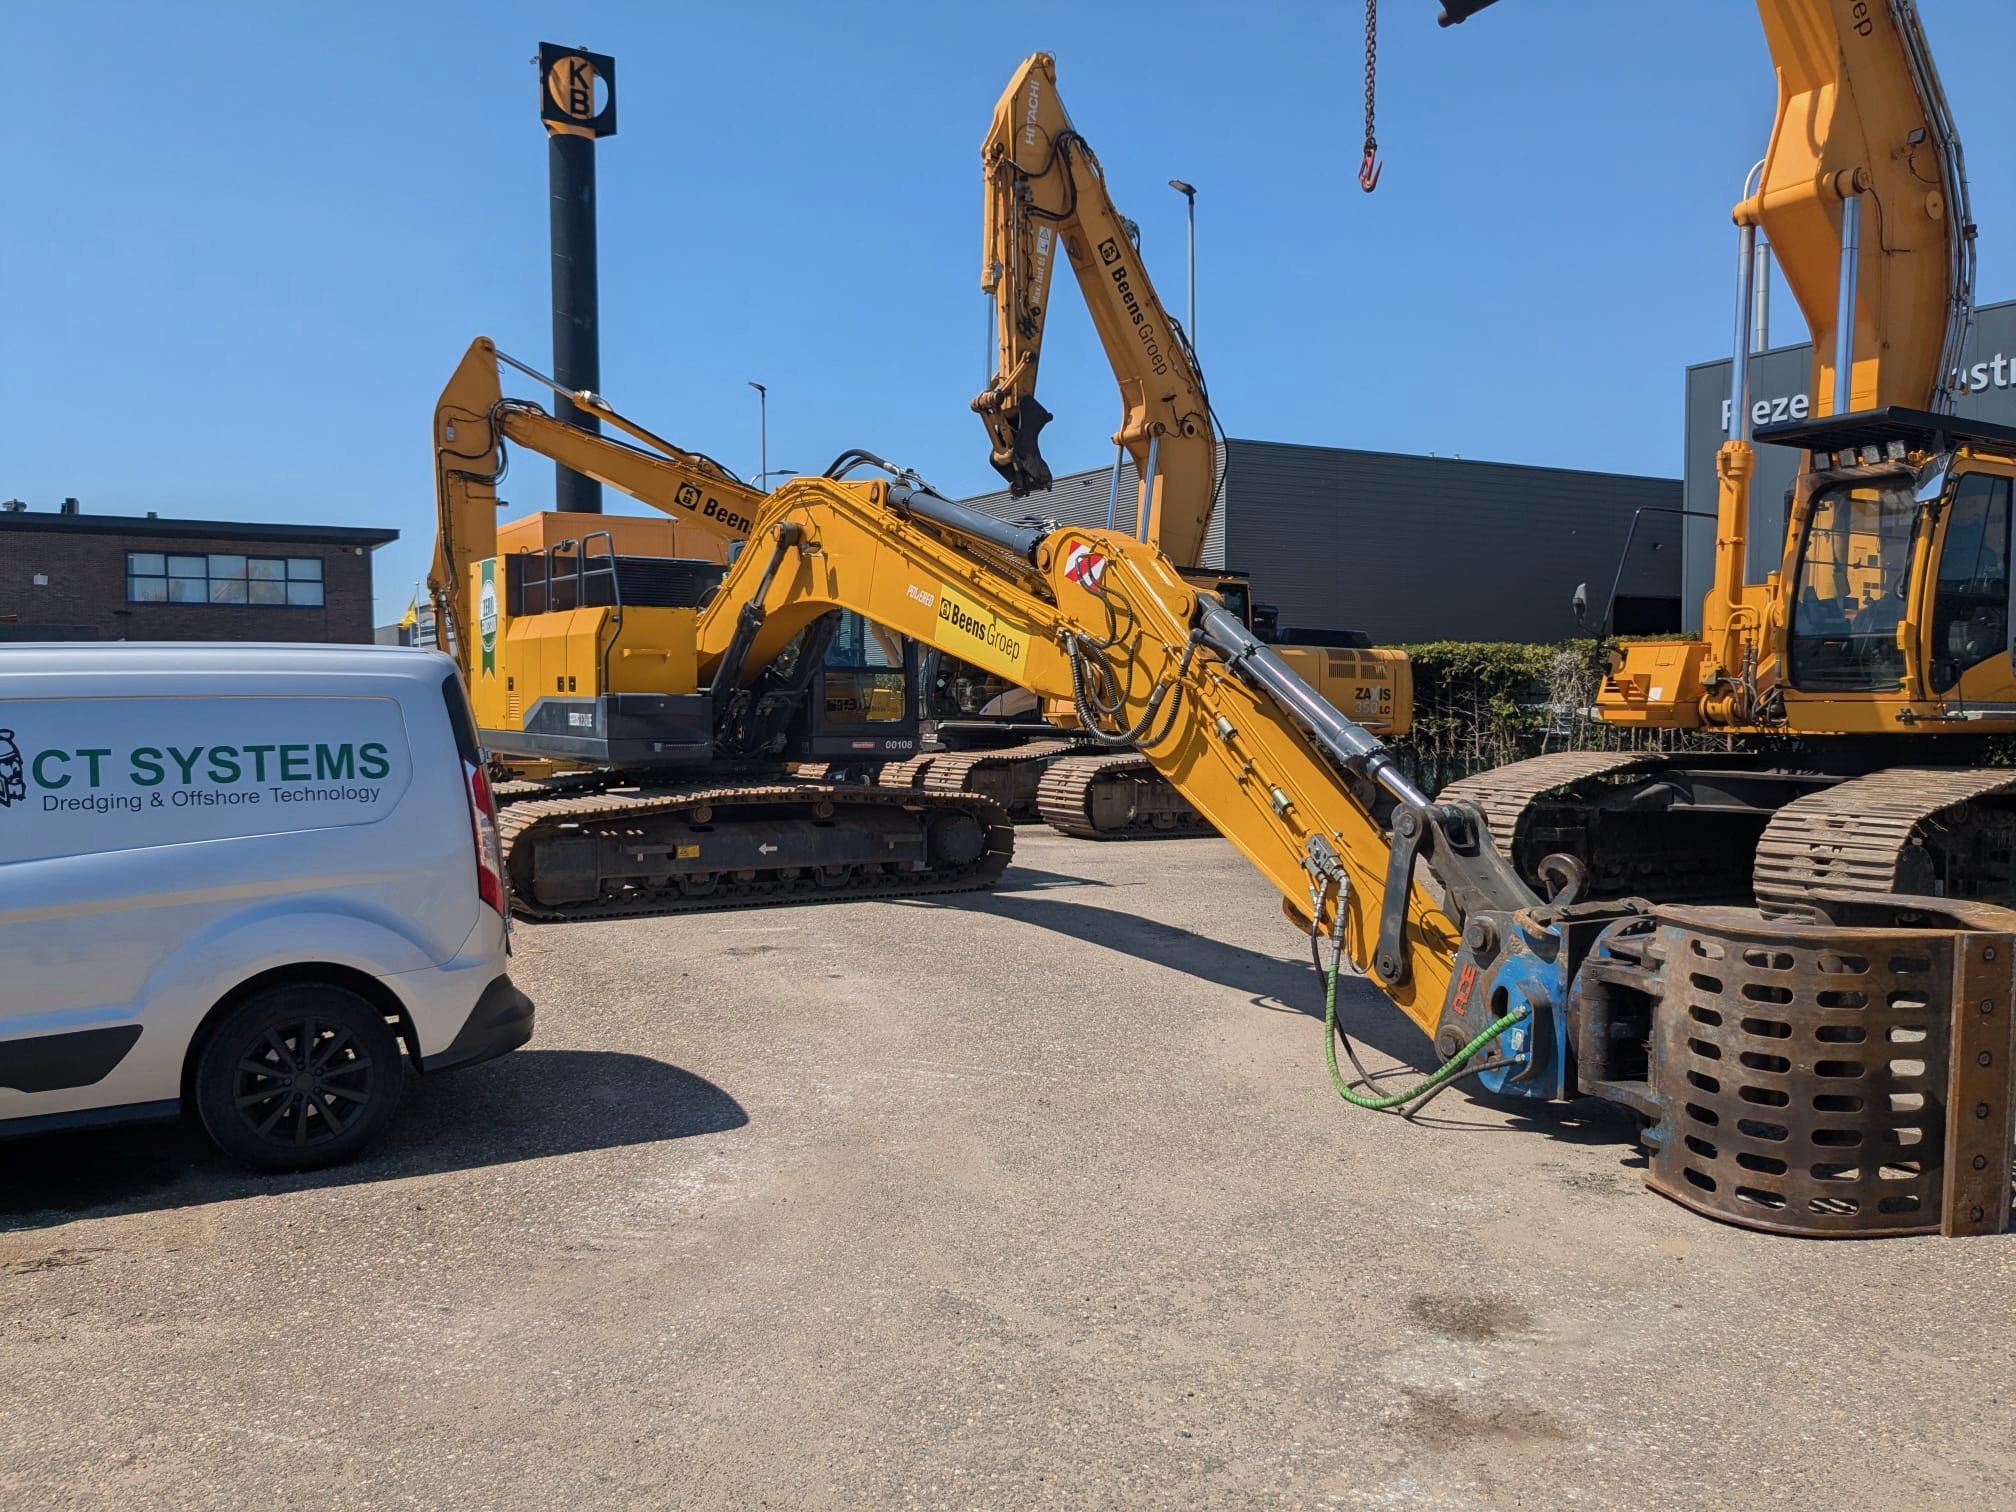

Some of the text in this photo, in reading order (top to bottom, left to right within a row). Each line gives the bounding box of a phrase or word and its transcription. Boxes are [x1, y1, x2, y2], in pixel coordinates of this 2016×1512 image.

[1852, 0, 1873, 37] ep
[1025, 80, 1040, 146] HITACHI
[1355, 685, 1391, 701] ZAXIS
[1379, 705, 1391, 714] LC
[32, 742, 390, 790] CT SYSTEMS
[43, 785, 381, 814] Dredging & Offshore Technology
